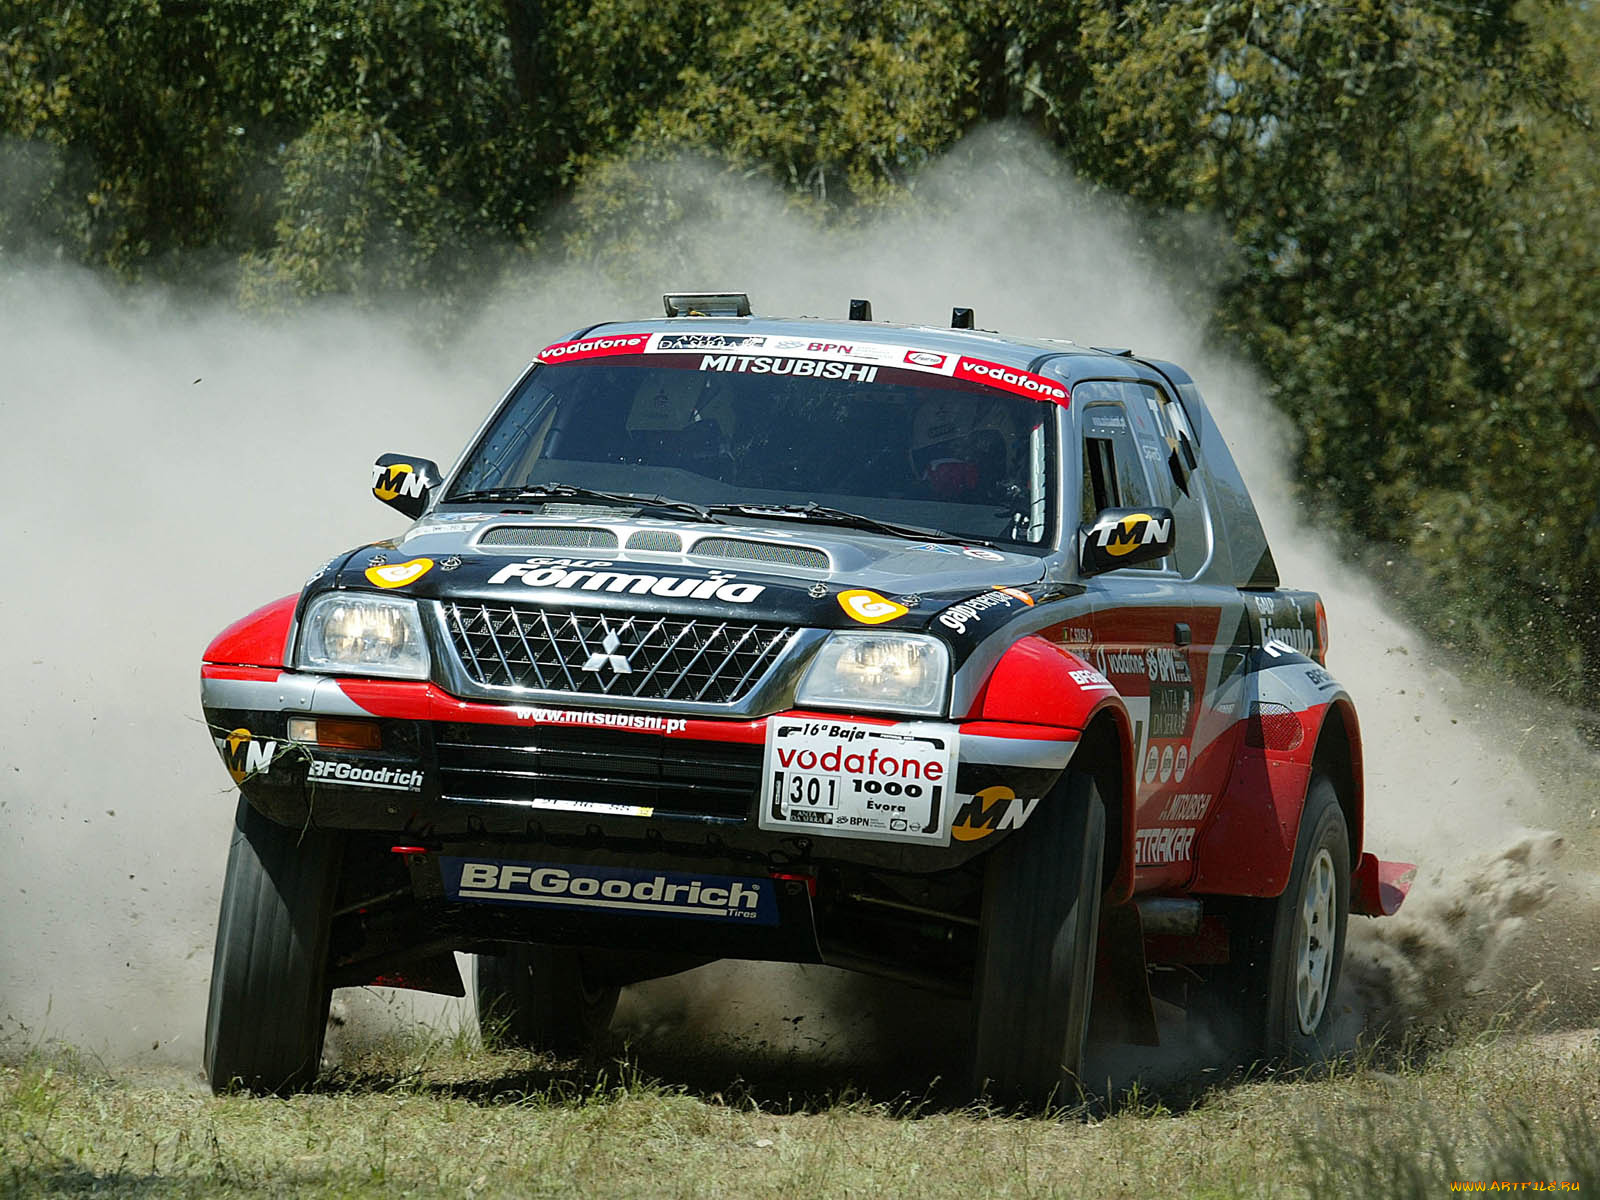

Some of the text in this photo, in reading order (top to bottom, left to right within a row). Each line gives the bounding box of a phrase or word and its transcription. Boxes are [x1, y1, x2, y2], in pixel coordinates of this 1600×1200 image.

[541, 337, 641, 358] vodafone
[806, 342, 853, 355] BPN
[700, 354, 879, 383] MITSUBISHI
[962, 361, 1066, 398] vodafone
[372, 465, 428, 499] TMN
[1096, 518, 1172, 547] TMN
[525, 557, 614, 569] GALP
[1108, 648, 1145, 674] vodafone
[828, 725, 866, 742] Baja
[308, 760, 422, 787] BFGoodrich
[777, 745, 943, 781] vodafone
[790, 775, 836, 806] 301
[852, 779, 922, 798] 1000
[850, 817, 869, 827] BPN
[459, 863, 759, 908] BFGoodrich
[728, 908, 757, 920] Tires
